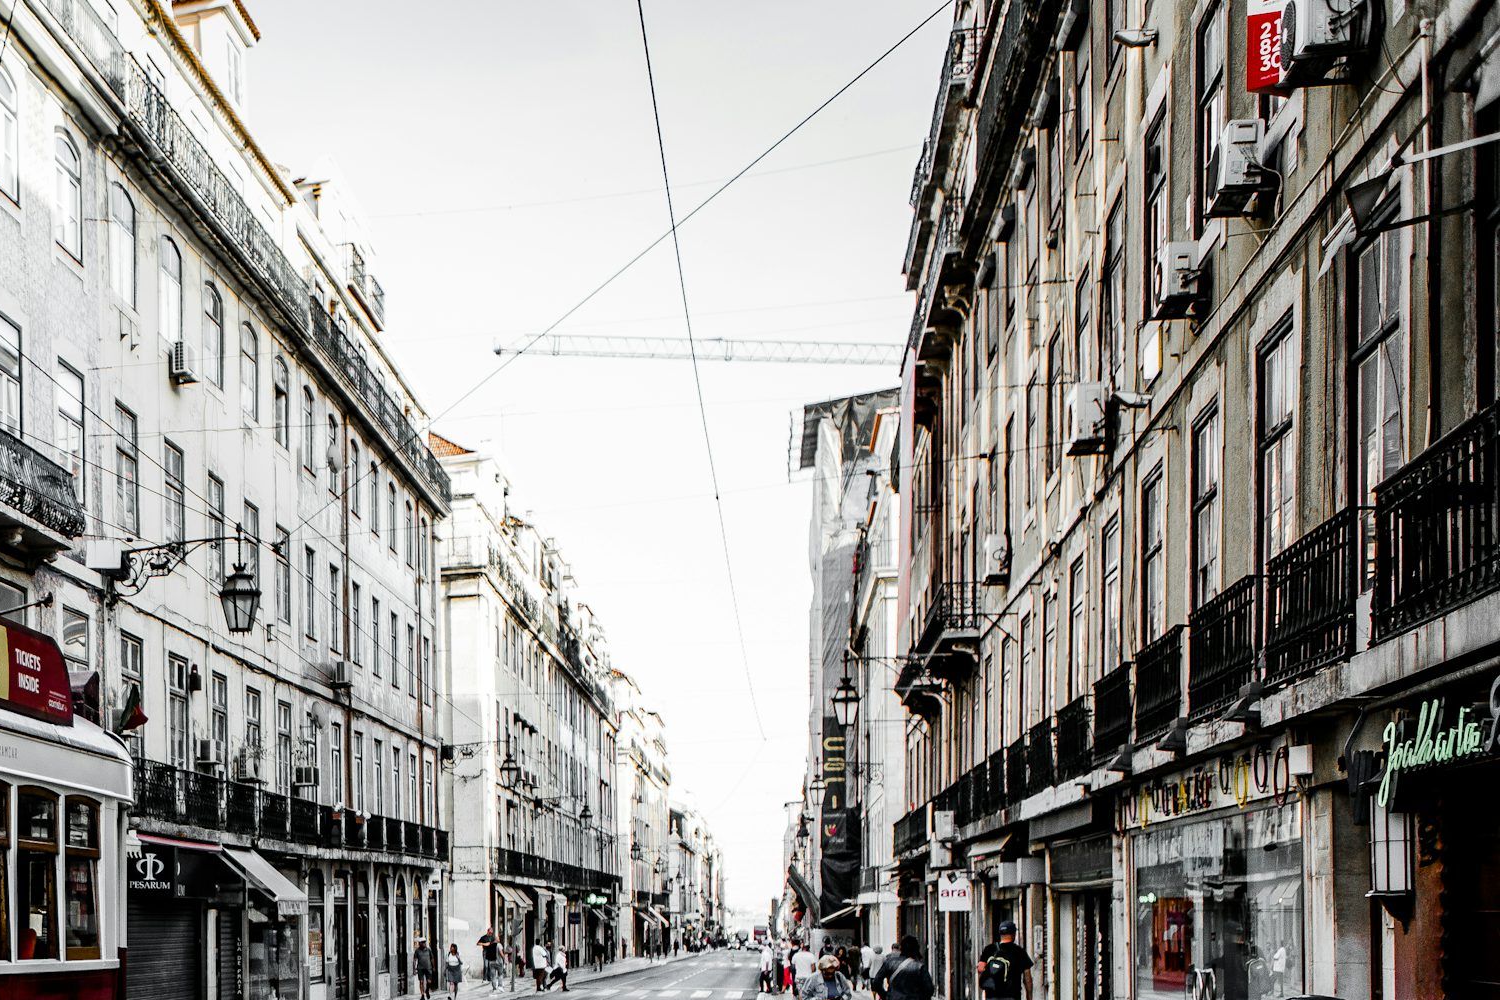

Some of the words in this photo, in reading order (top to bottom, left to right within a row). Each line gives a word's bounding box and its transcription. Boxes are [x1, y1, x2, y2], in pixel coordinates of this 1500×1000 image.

[15, 648, 41, 671] TICKETS
[18, 672, 40, 694] INSIDE
[129, 880, 171, 890] PESARUM
[941, 889, 966, 897] ara
